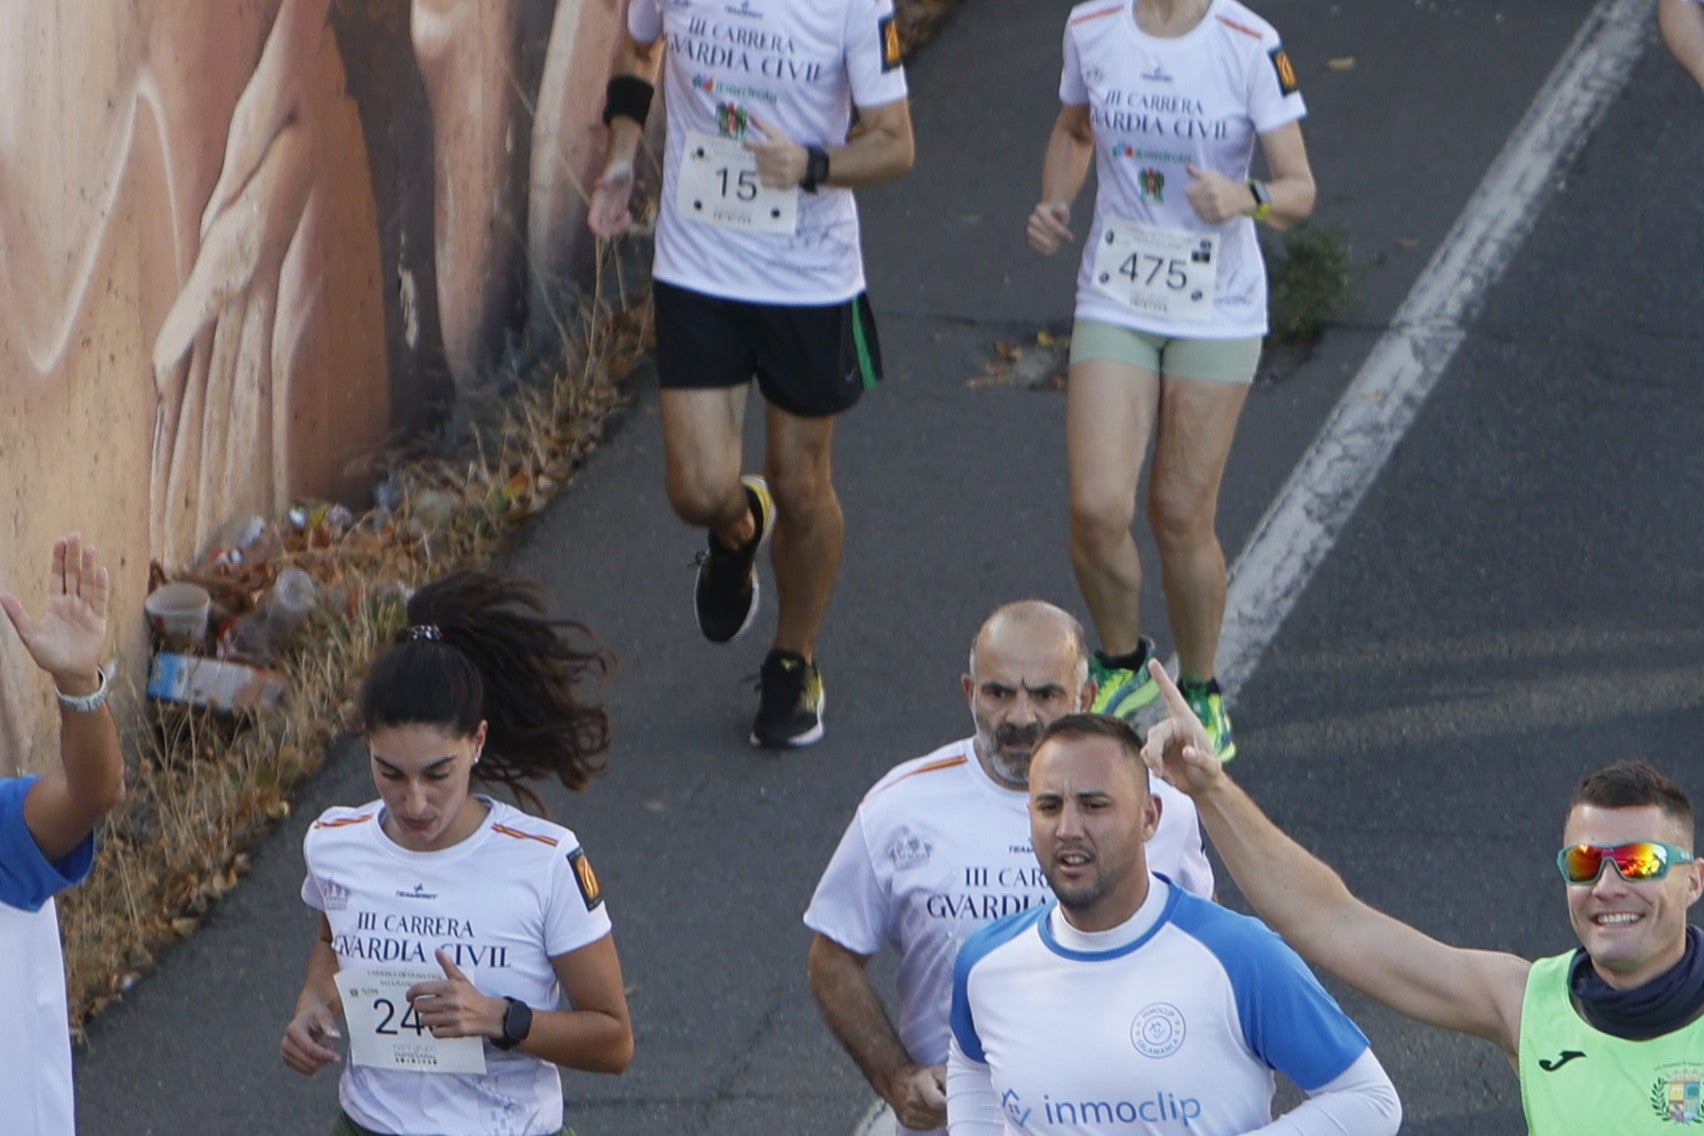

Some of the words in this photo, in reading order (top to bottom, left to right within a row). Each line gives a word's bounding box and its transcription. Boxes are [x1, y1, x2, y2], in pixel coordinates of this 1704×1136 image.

[670, 33, 749, 72] VARDIA
[712, 23, 794, 53] CARRERA
[1127, 90, 1203, 115] CARRERA
[715, 167, 757, 201] 15
[1119, 253, 1187, 290] 475
[965, 867, 988, 887] III
[357, 912, 376, 931] III
[384, 914, 475, 938] CARRERA
[373, 998, 434, 1036] 24
[1044, 1091, 1202, 1127] inmoclip
